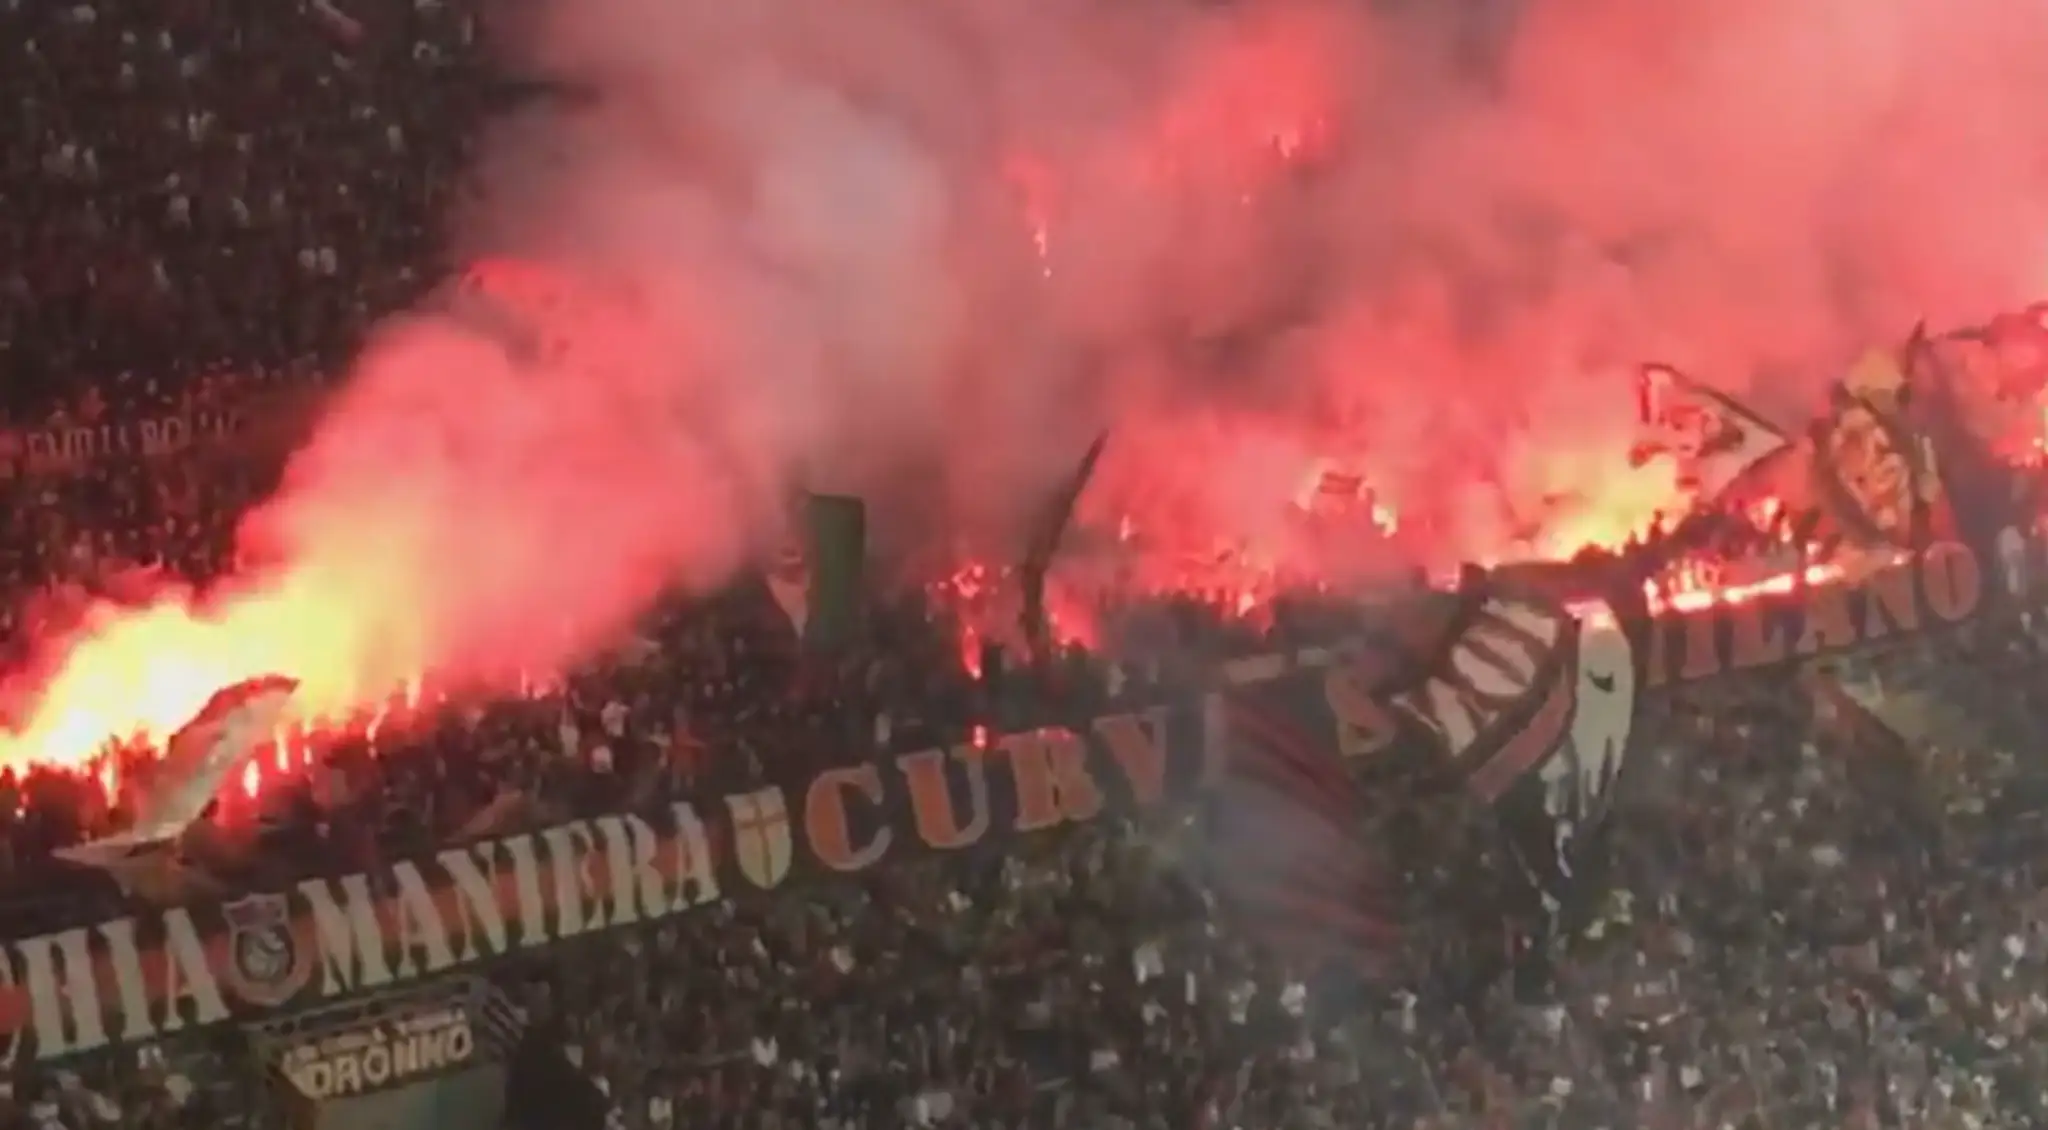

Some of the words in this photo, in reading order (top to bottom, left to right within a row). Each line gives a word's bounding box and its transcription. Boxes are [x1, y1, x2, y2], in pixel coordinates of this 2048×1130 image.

[0, 906, 232, 1069] HIA
[297, 802, 721, 995] MANIERA
[805, 706, 1167, 871] CURV
[1646, 541, 1982, 687] ILANO
